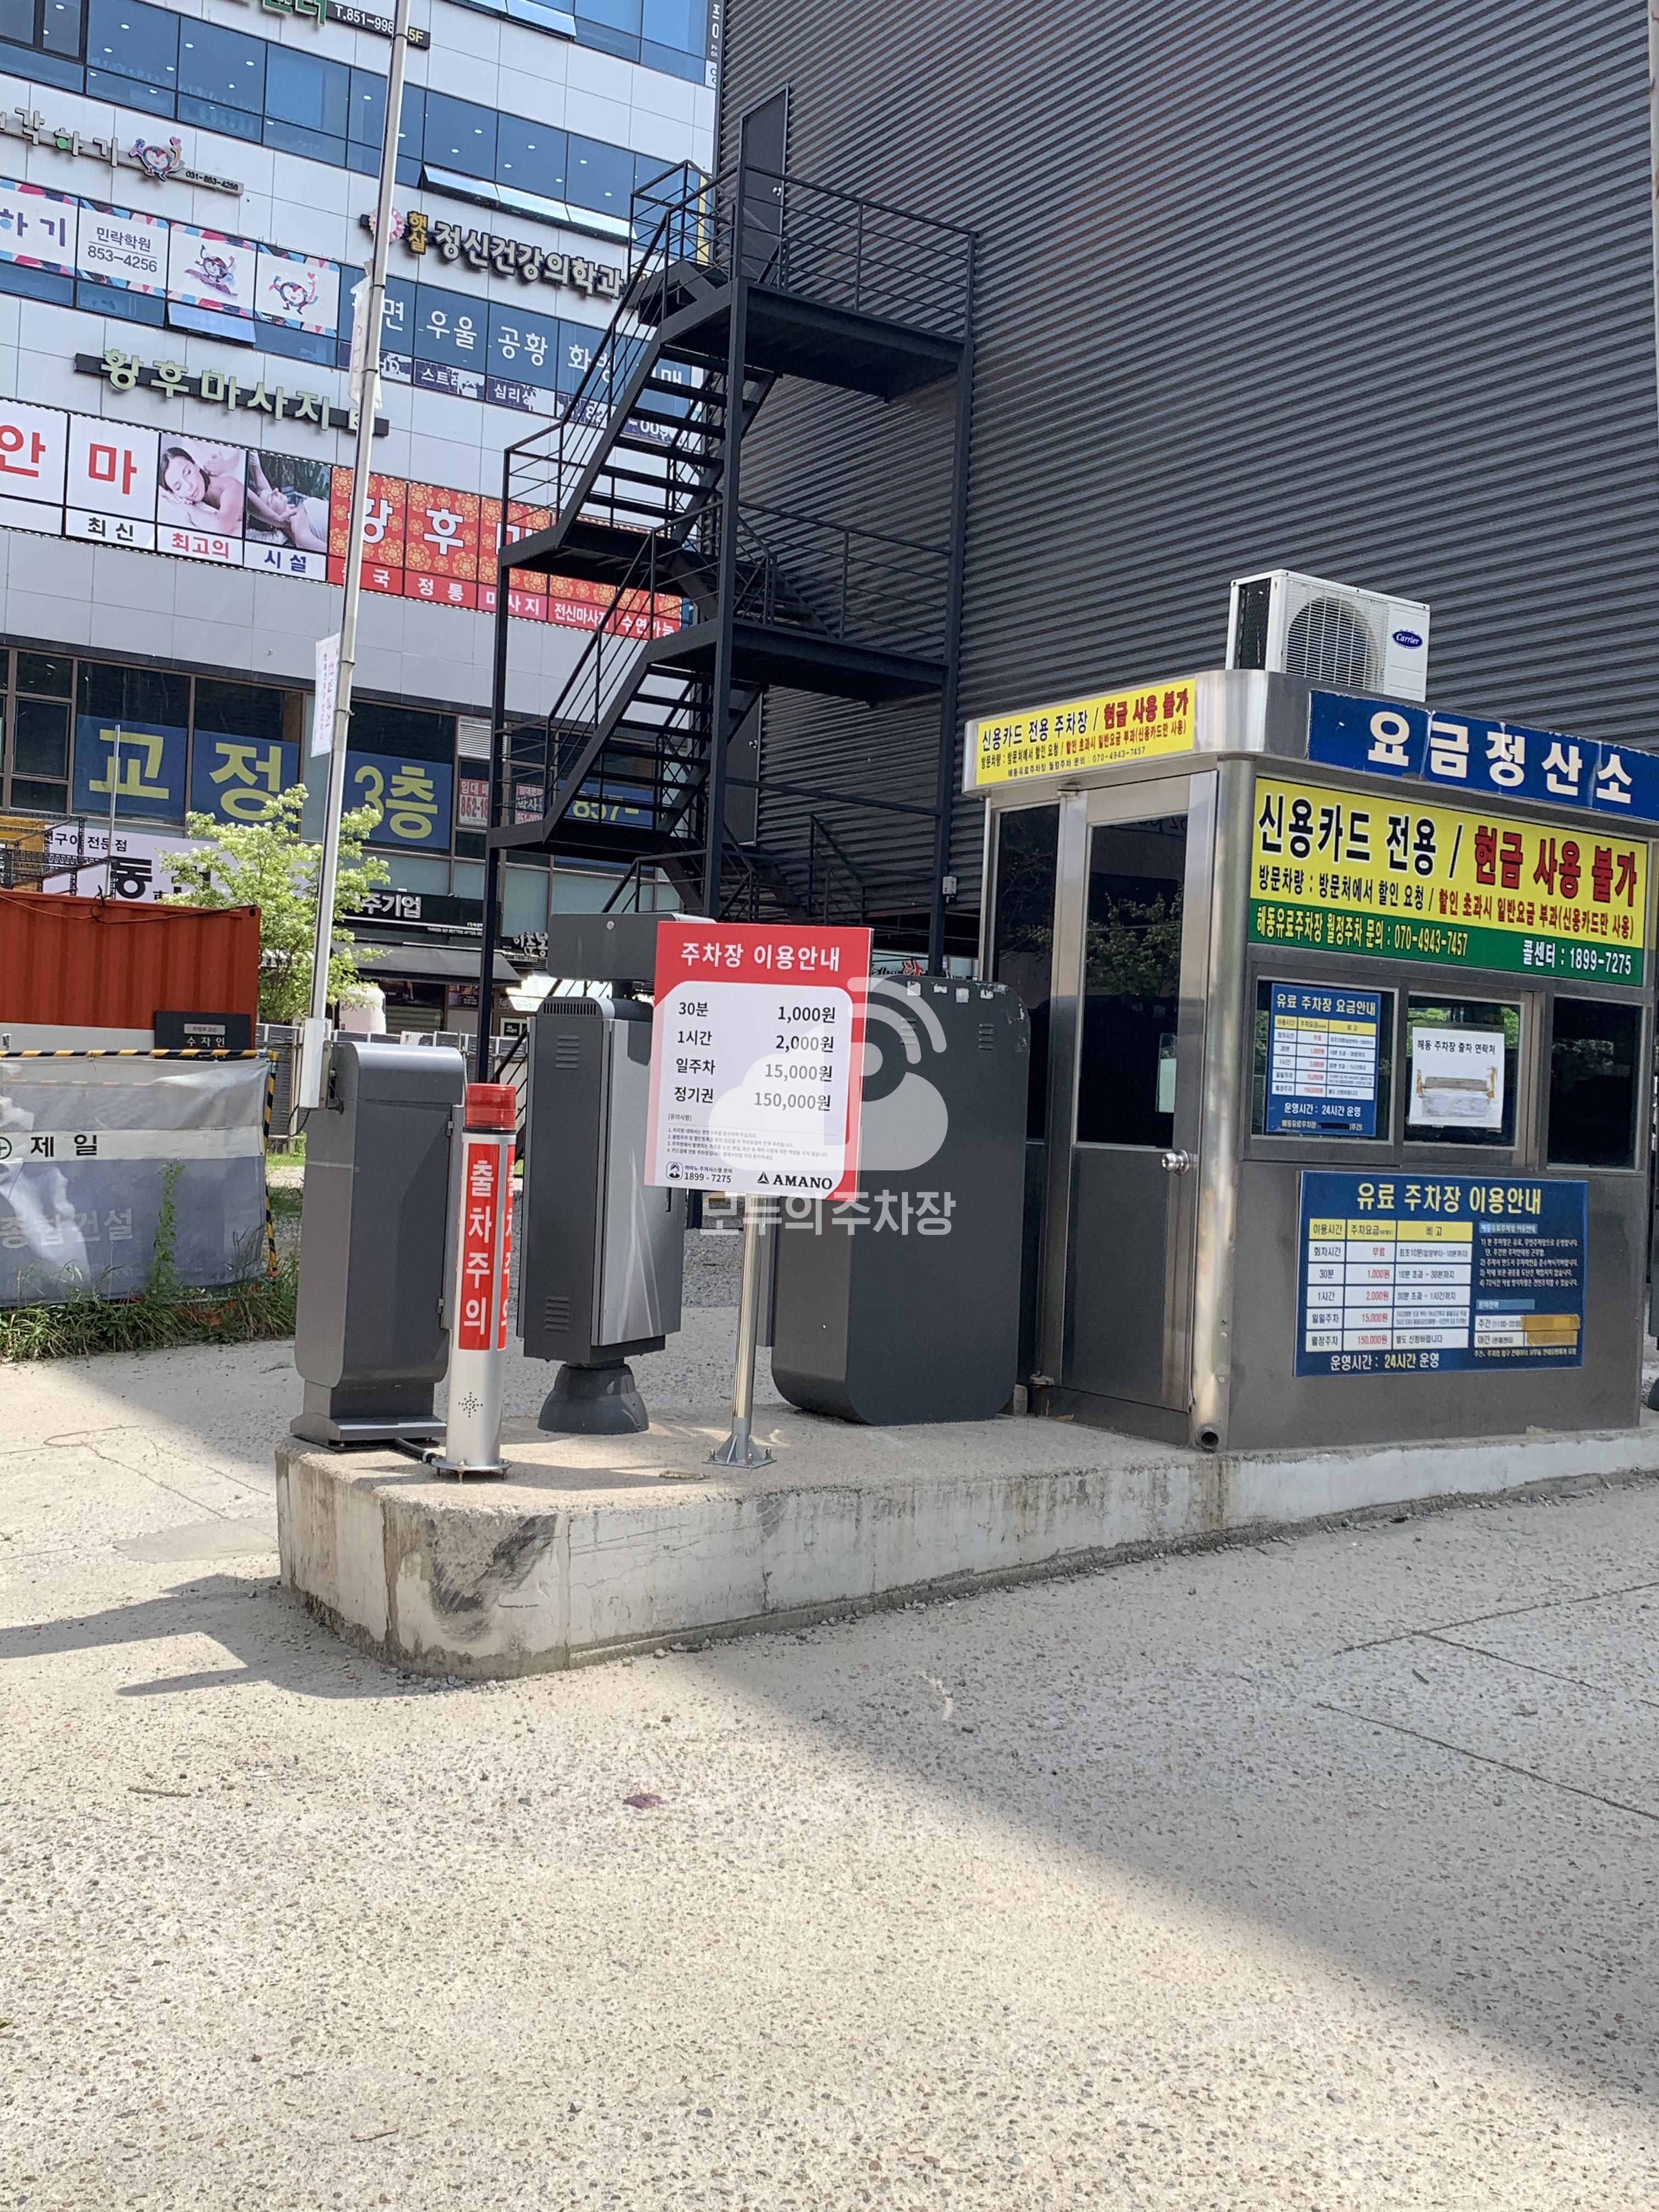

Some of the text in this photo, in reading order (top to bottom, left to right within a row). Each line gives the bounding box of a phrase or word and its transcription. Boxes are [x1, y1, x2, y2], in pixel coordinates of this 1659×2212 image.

[408, 29, 424, 43] 5F
[0, 107, 119, 167] 각하기
[97, 227, 151, 252] 민락학원
[88, 245, 157, 273] 853-4256
[426, 310, 478, 351] 우울
[498, 325, 548, 368] 공황
[101, 349, 330, 430] 황후마사지
[172, 532, 229, 559] 최고의
[1396, 633, 1420, 645] Carrier
[982, 725, 1023, 752] 신용카드
[1028, 718, 1049, 743] 전용
[1054, 709, 1088, 738] 주차장
[1104, 701, 1128, 730] 현금
[1132, 695, 1158, 724] 사용
[1163, 688, 1189, 719] 불가
[1092, 746, 1146, 763] 070-4943-7457
[1367, 711, 1633, 804] 요금정산소
[1258, 793, 1372, 864] 신용카드
[1385, 814, 1438, 877] 전용
[1474, 825, 1523, 890] 현금
[1533, 837, 1581, 900] 사용
[1591, 844, 1638, 908] 불가
[356, 893, 421, 919] 주기업
[1259, 865, 1304, 895] 방문차량
[1319, 873, 1374, 905] 방문처에서
[1379, 880, 1399, 907] 할인
[1403, 884, 1424, 911] 요청
[1438, 888, 1459, 916] 할인
[1463, 891, 1493, 921] 초과시
[1497, 897, 1535, 927] 일반요금
[1612, 914, 1634, 941] 사용)
[1256, 905, 1469, 957] 해동유료주차장 월정주차 문의 070-4943-7457
[680, 942, 743, 969] 주차장
[754, 944, 840, 973] 이용안내
[1522, 939, 1632, 976] 콜센터 1899-7275
[678, 1002, 836, 1024] 30분 1,000원
[1276, 994, 1376, 1017] 유료 주차장 요금안내
[677, 1030, 834, 1053] 1시간 2,000원
[1434, 1040, 1456, 1053] 주차장
[1474, 1043, 1496, 1055] 연락처
[676, 1058, 832, 1082] 일주차 15,000원
[674, 1086, 831, 1112] 정기권 150,000원
[1321, 1105, 1345, 1116] 24시간
[1346, 1106, 1362, 1118] 운영
[772, 1173, 833, 1190] AMANO
[1357, 1182, 1542, 1215] 유료 주차장 이용안내
[1313, 1224, 1342, 1235] 이용시간
[464, 1160, 494, 1335] 출차주의
[1372, 1247, 1386, 1257] 무료
[1319, 1268, 1334, 1279] 30분
[1317, 1291, 1335, 1302] 1시간
[1384, 1353, 1417, 1369] 24시간
[1419, 1352, 1440, 1369] 운영
